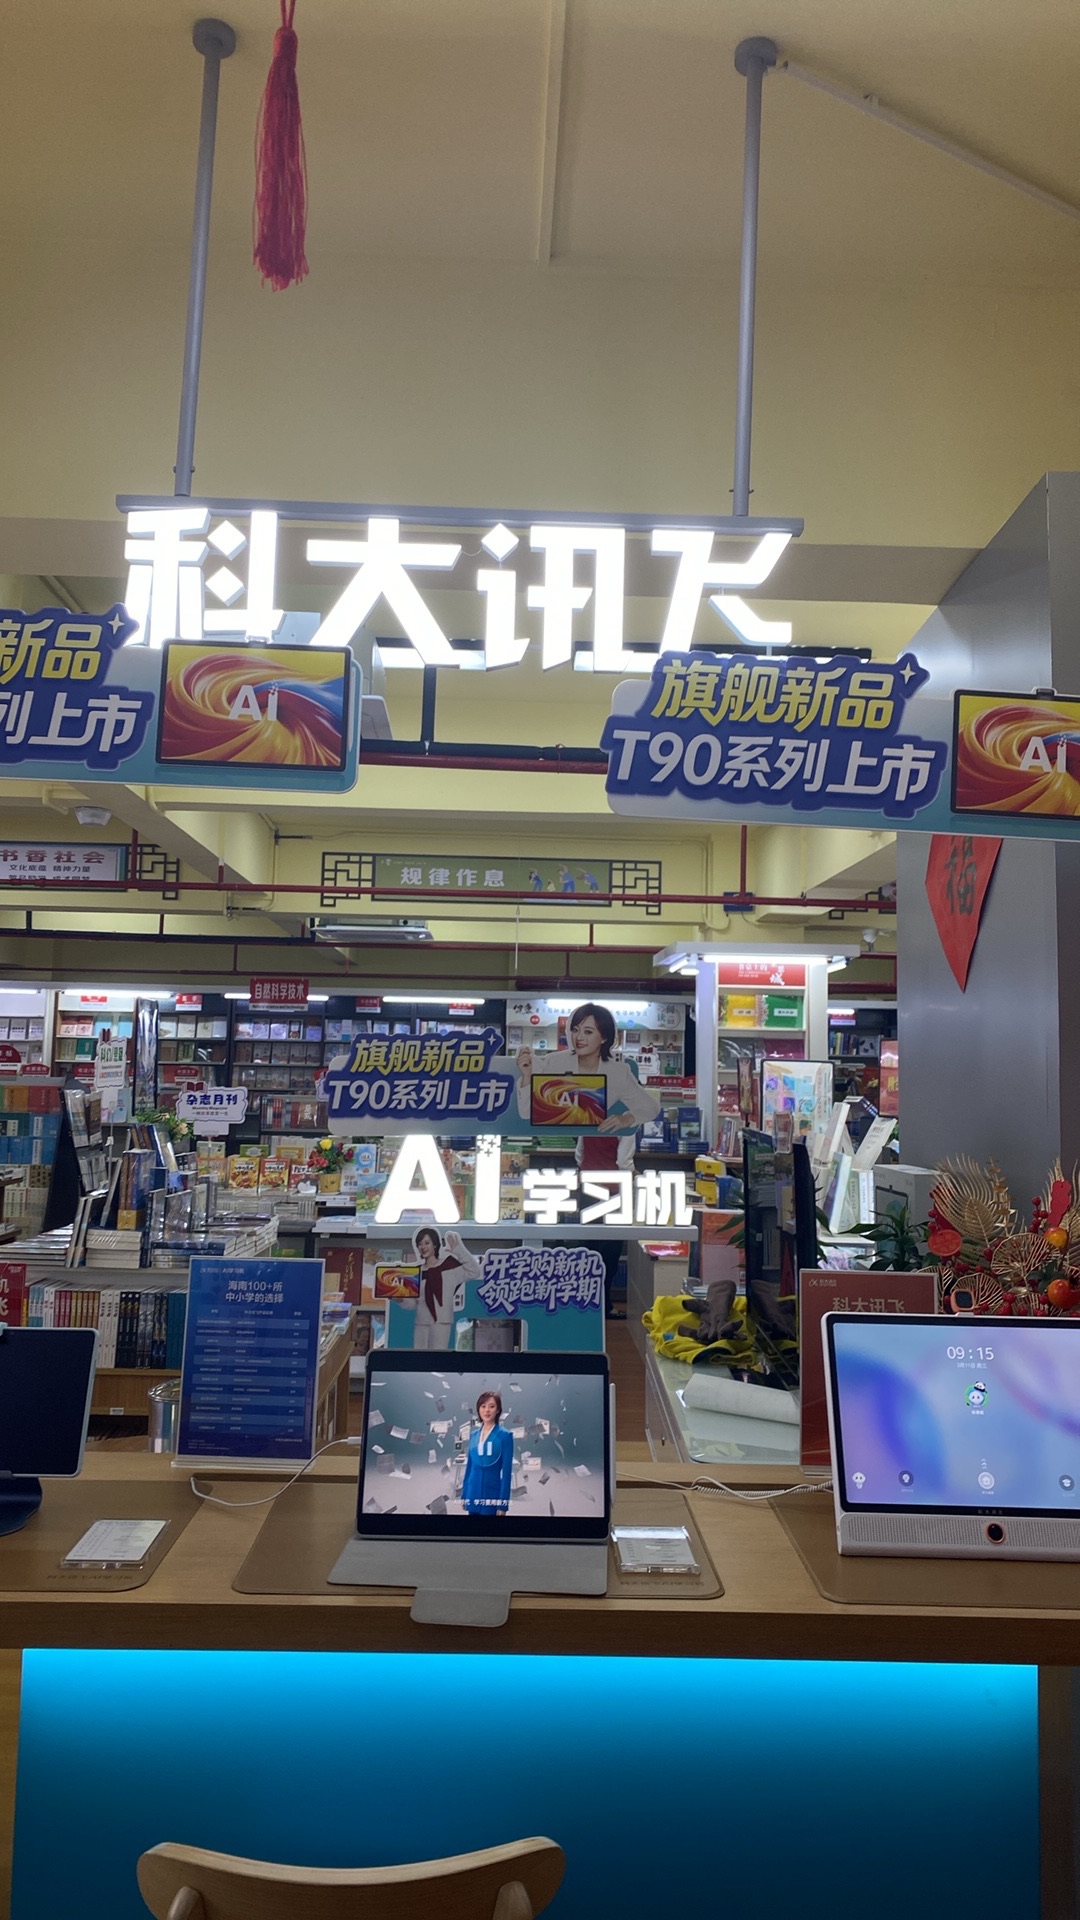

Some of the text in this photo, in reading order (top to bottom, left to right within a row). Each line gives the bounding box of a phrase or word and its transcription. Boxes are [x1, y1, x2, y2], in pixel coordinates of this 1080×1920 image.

[124, 508, 794, 672] 科大讯飞
[650, 659, 895, 732] 旗舰新品
[612, 729, 936, 802] T90系列上市
[0, 849, 105, 864] 书香社会
[400, 866, 506, 887] 规律作息
[254, 982, 305, 1000] 自然科学技术
[350, 1038, 485, 1076] 旗舰新品
[186, 1094, 238, 1106] 杂志月刊
[328, 1079, 508, 1112] T90系列上市
[485, 1250, 603, 1279] 开学购新机
[228, 1280, 283, 1291] 海南100+所
[477, 1277, 603, 1314] 领跑新学期
[225, 1292, 284, 1304] 中小学的选择
[832, 1296, 905, 1313] 科大讯飞
[946, 1346, 994, 1361] 09:15
